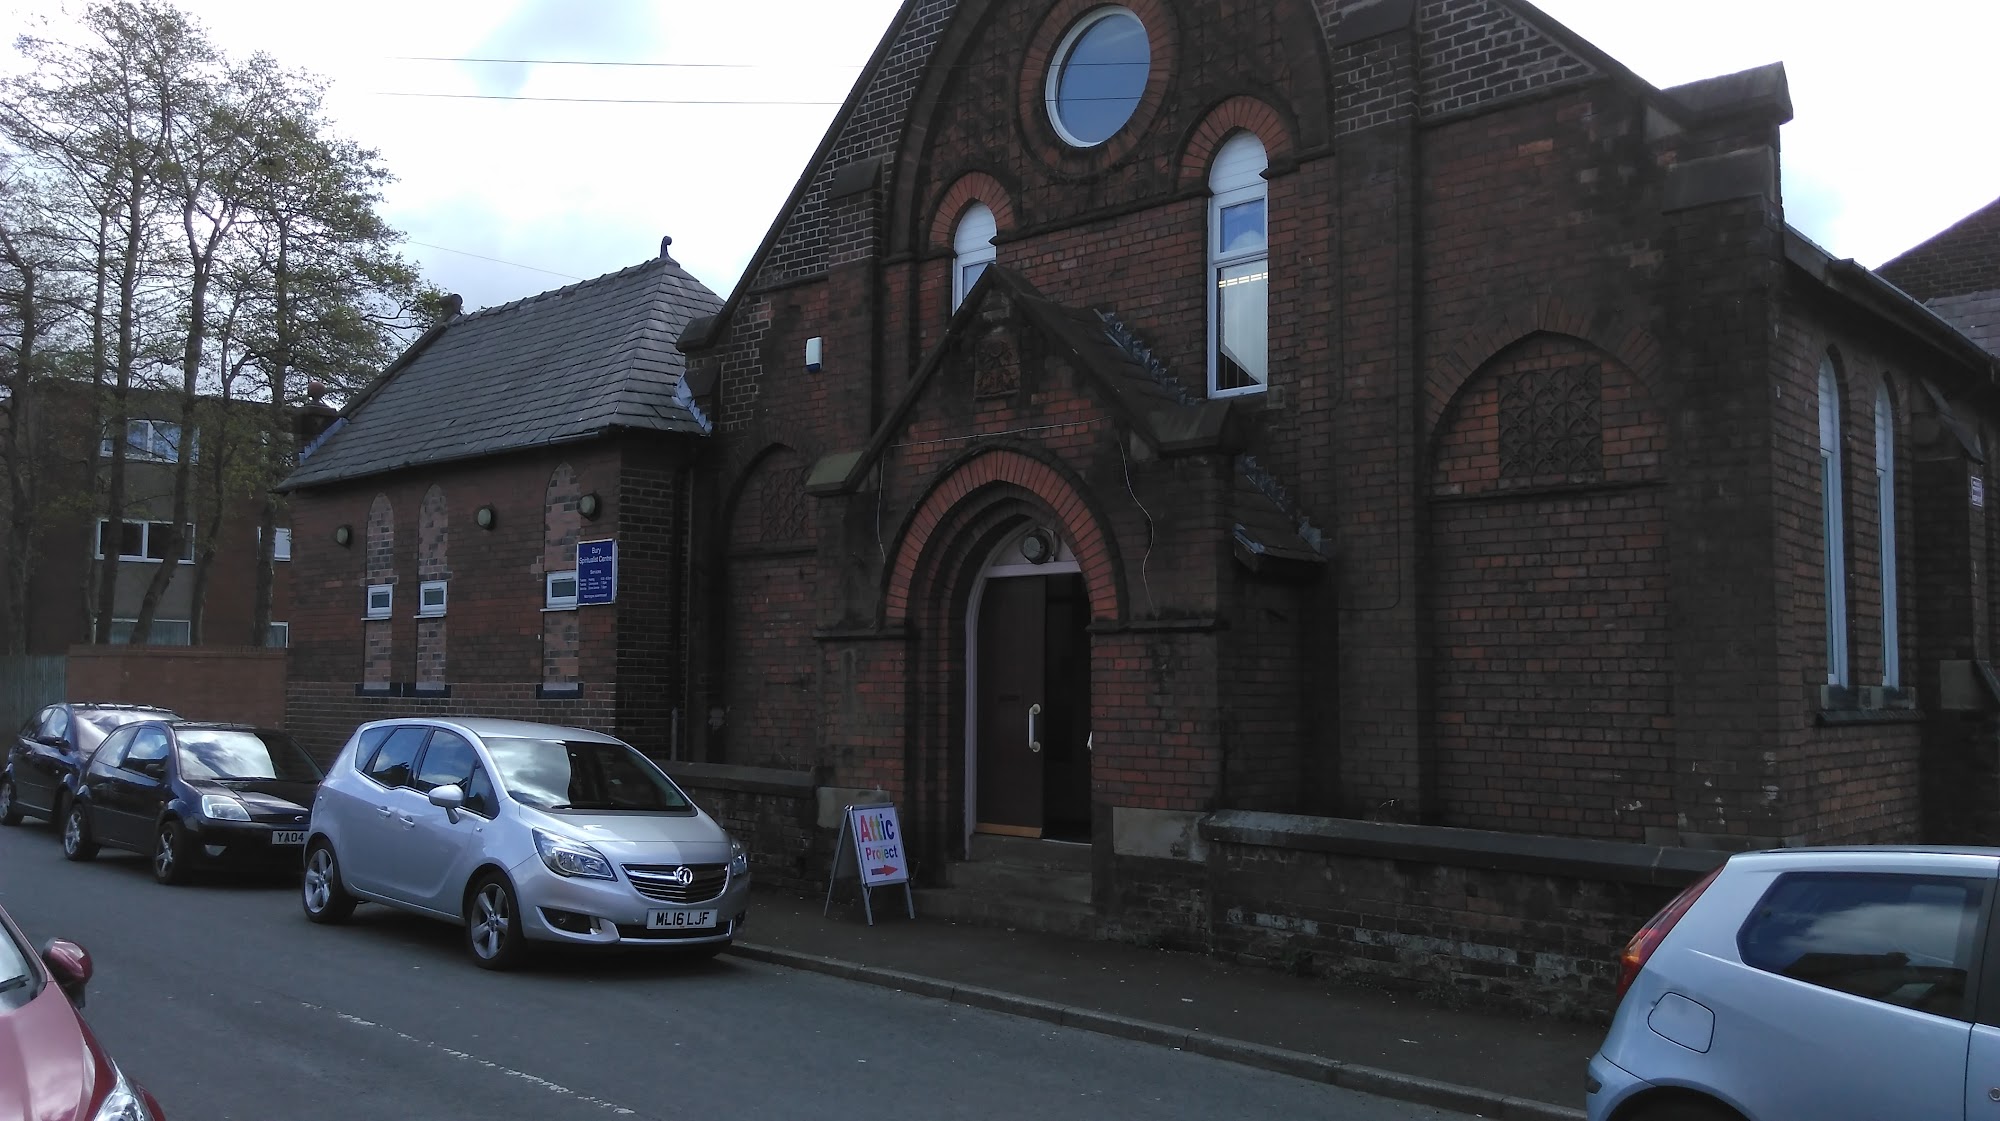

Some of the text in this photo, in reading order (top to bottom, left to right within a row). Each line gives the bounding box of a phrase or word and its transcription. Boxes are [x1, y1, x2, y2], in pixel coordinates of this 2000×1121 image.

[579, 556, 599, 565] Spiritualist
[860, 814, 895, 842] Attic
[277, 832, 304, 843] YA04
[865, 845, 898, 862] Project
[656, 911, 710, 926] ML16 LJF
